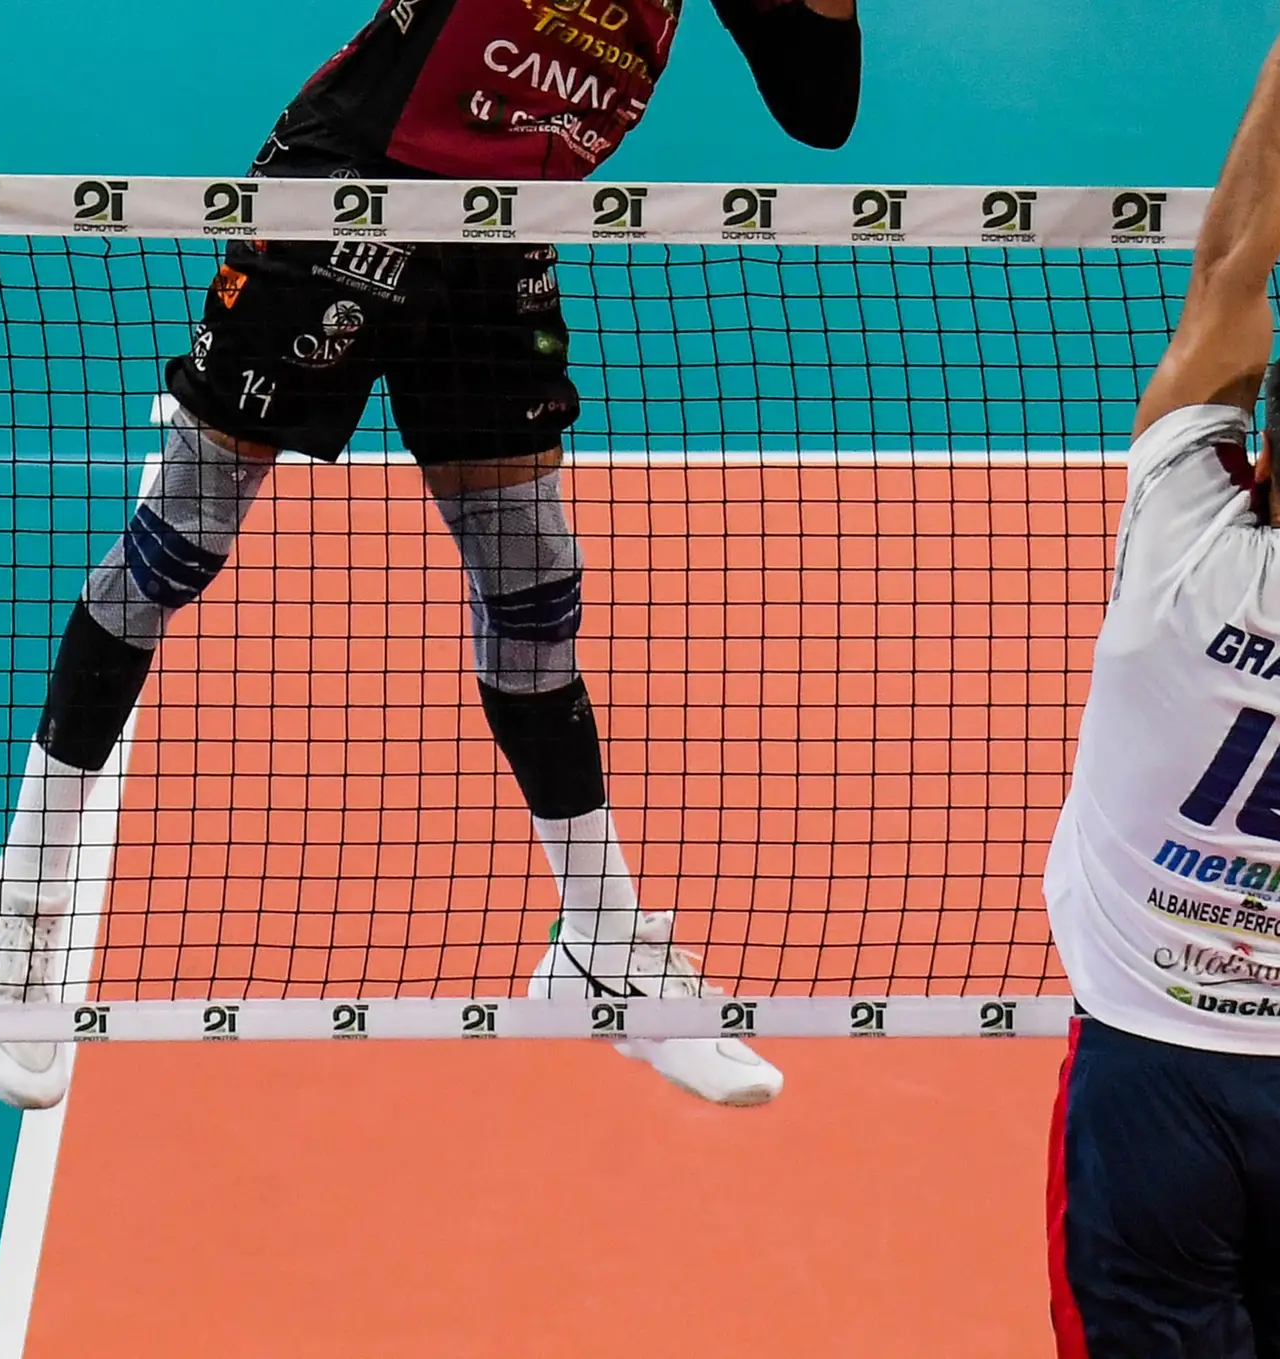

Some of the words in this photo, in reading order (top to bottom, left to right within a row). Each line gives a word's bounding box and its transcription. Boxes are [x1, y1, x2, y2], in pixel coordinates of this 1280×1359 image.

[73, 223, 129, 233] DOMOTEK
[203, 225, 259, 235] DOMOTEK
[333, 227, 389, 237] DOMOTEK
[462, 228, 518, 238] DOMOTEK
[592, 230, 648, 240] DOMOTEK
[722, 231, 778, 241] DOMOTEK
[852, 232, 908, 242] DOMOTEK
[982, 233, 1038, 243] DOMOTEK
[1111, 234, 1167, 244] DOMOTEK
[1147, 887, 1232, 925] ALBANESE
